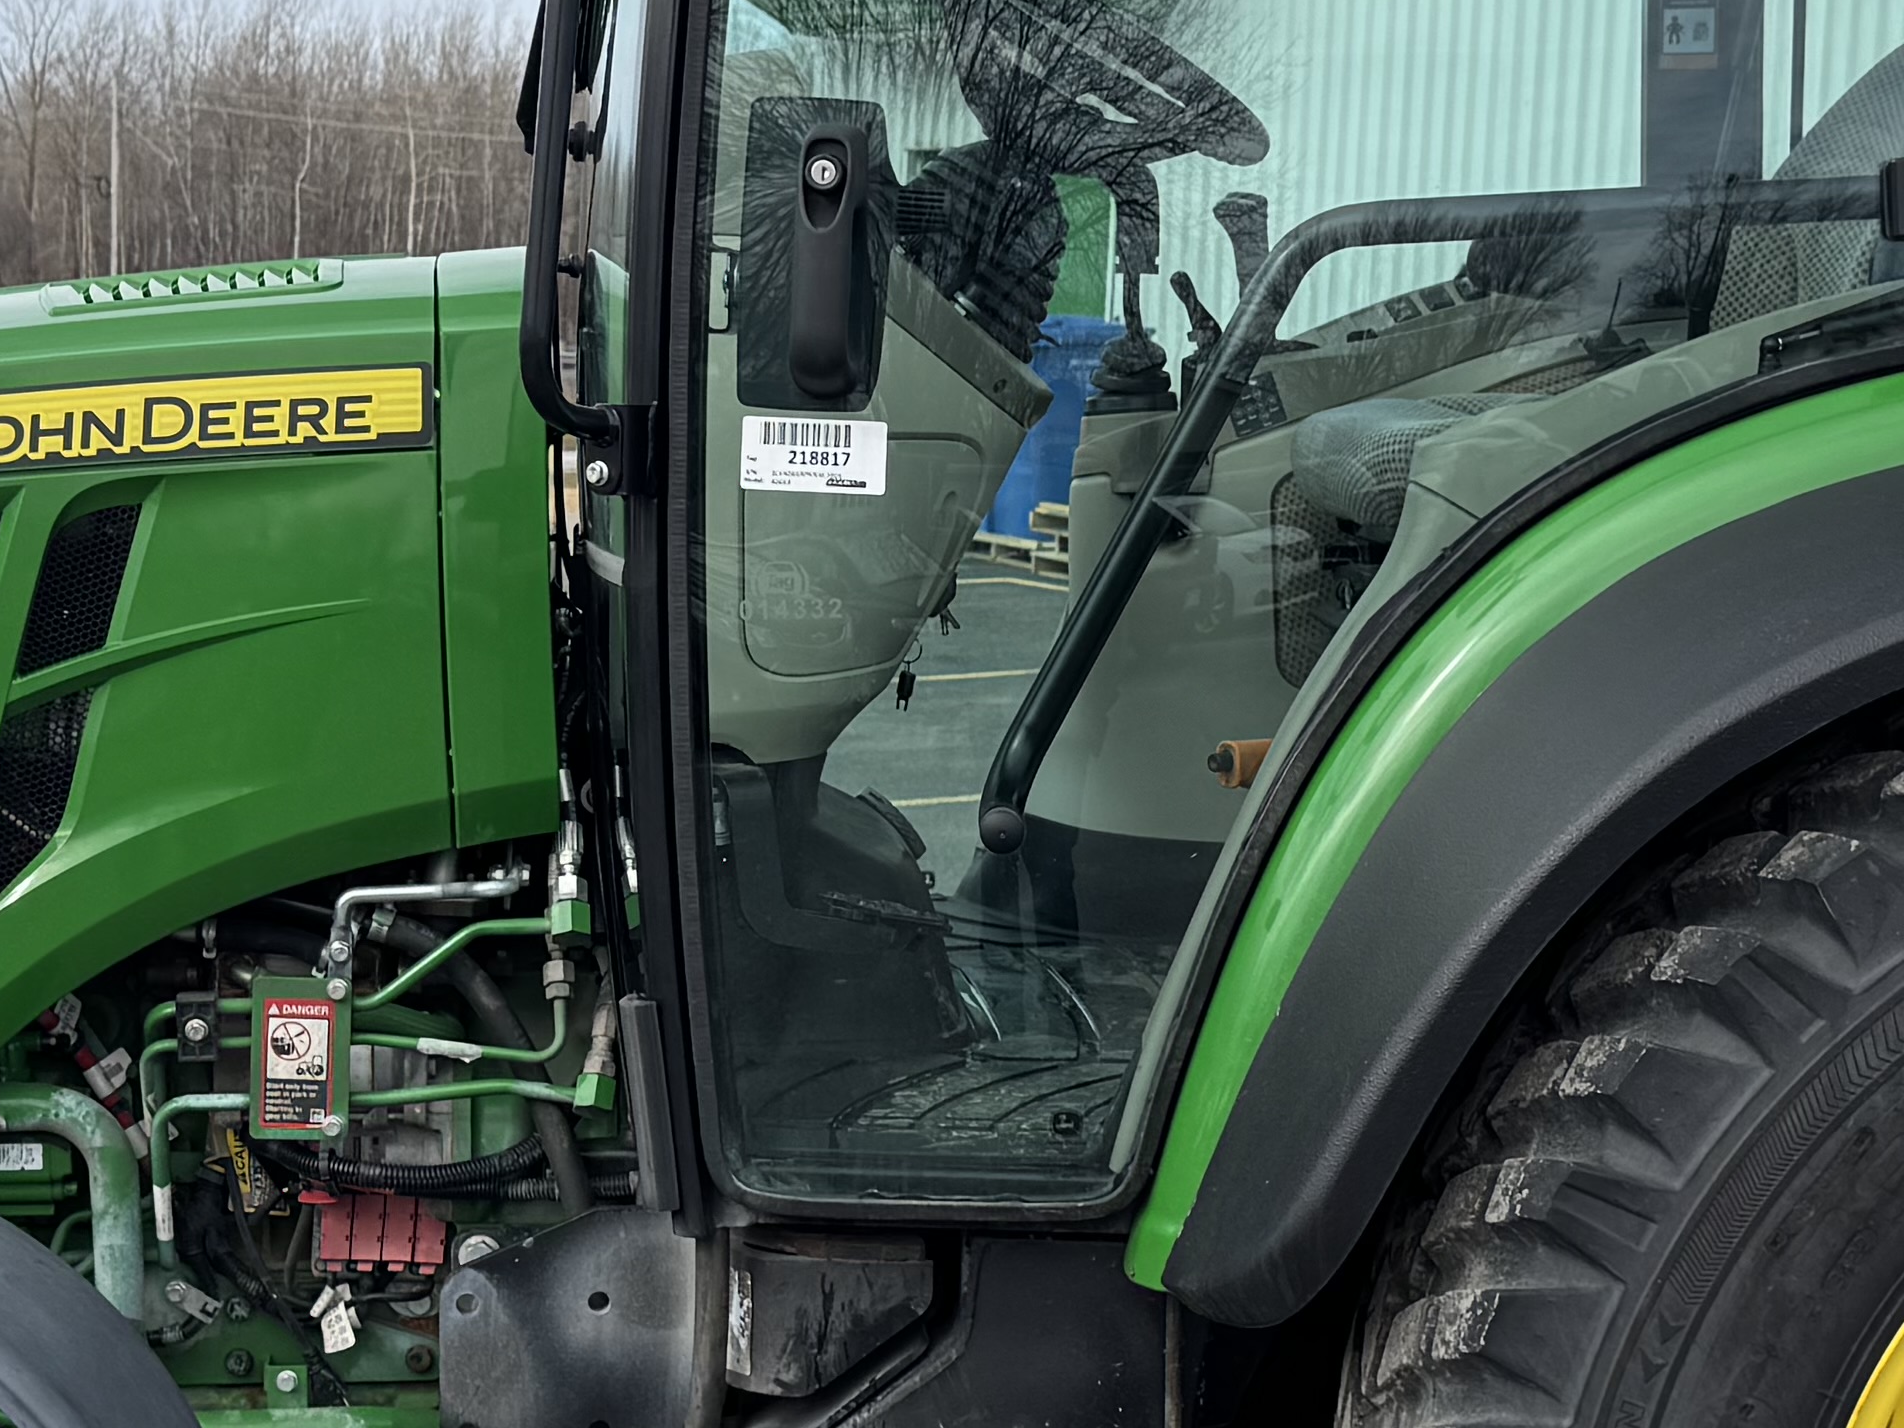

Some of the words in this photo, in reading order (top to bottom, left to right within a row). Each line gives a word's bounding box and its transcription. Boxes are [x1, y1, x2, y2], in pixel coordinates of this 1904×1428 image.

[142, 395, 374, 445] DEERE
[788, 450, 851, 466] 218817
[282, 1004, 329, 1016] DANGER
